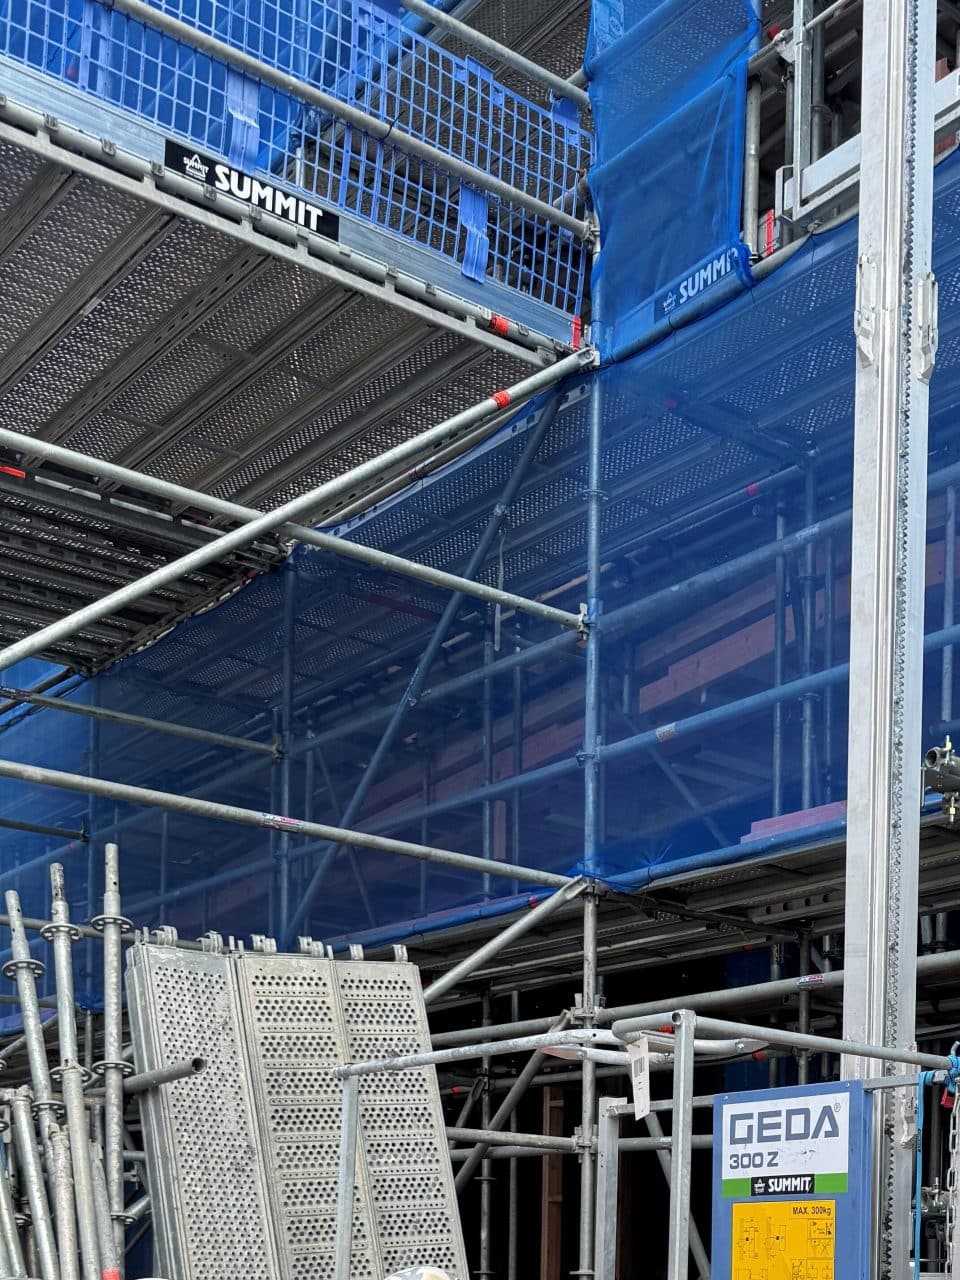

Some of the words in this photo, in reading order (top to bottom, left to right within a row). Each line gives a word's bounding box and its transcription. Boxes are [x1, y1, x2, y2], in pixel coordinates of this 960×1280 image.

[214, 164, 323, 231] SUMMIT
[729, 1105, 840, 1145] GEDA
[729, 1152, 764, 1170] 300
[767, 1151, 779, 1168] Z
[768, 1177, 812, 1192] SUMMIT
